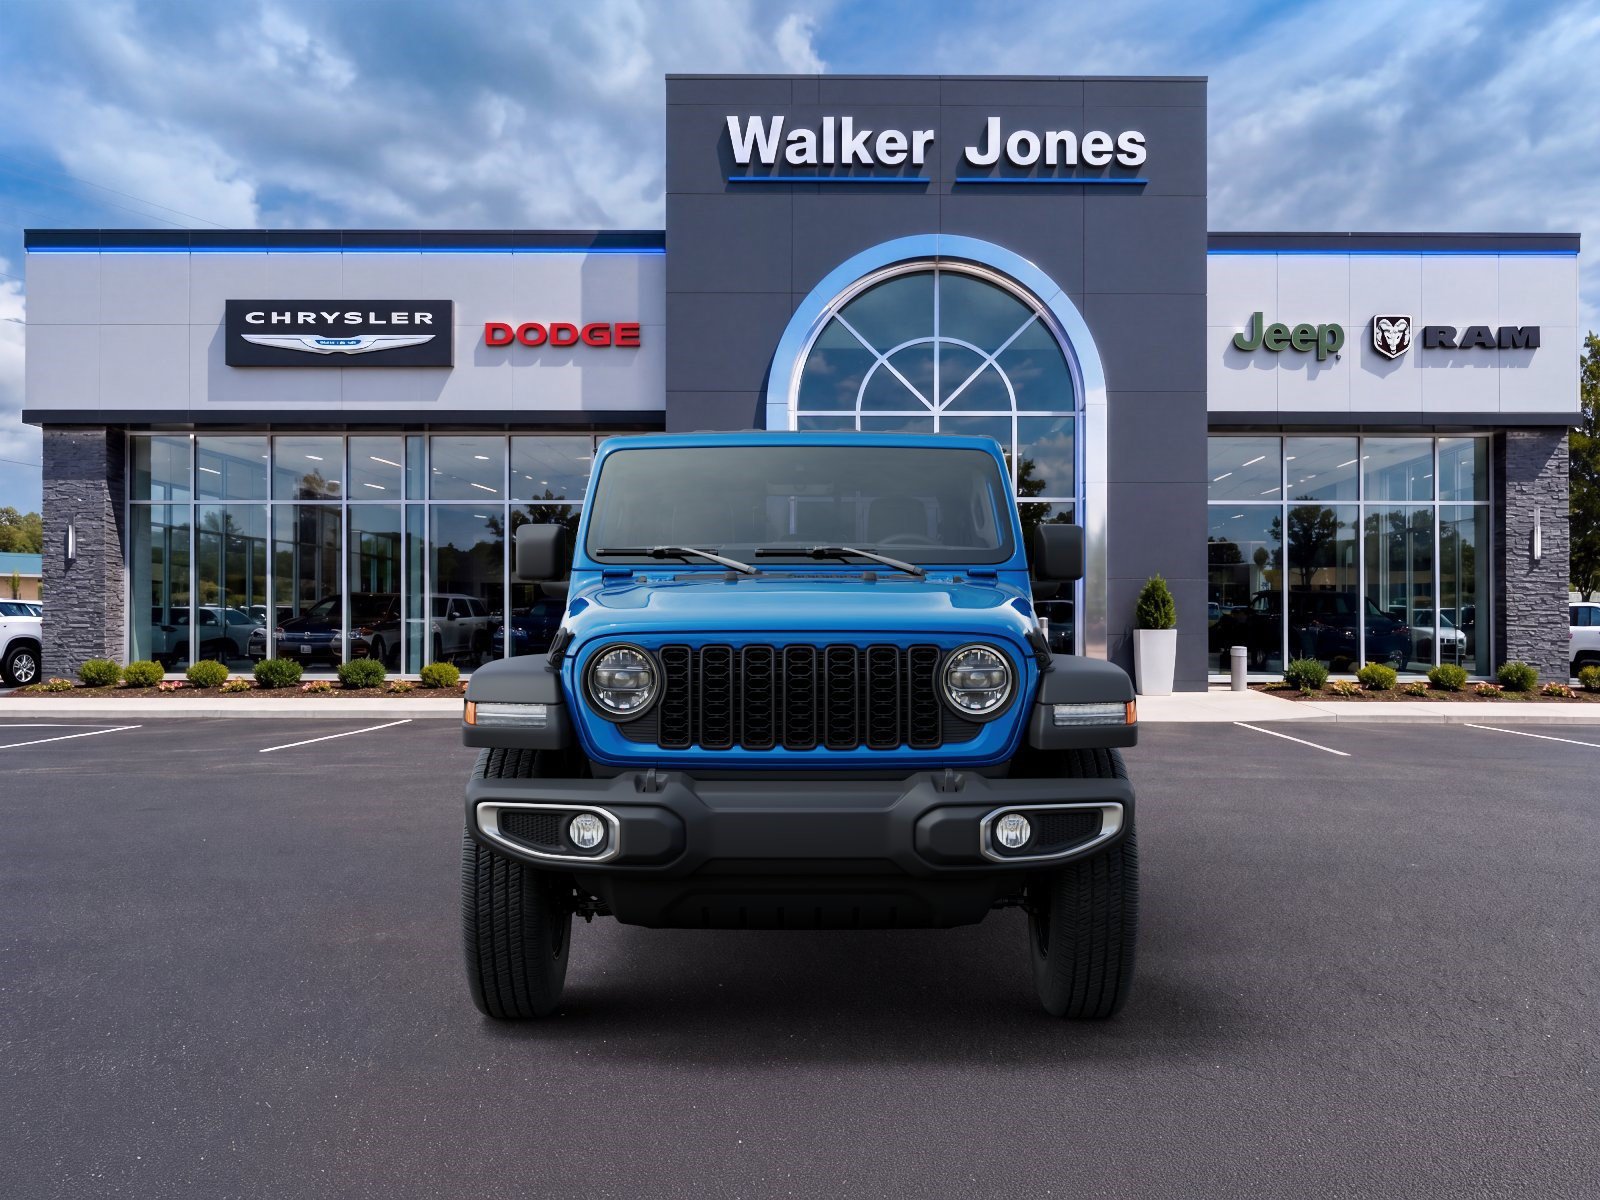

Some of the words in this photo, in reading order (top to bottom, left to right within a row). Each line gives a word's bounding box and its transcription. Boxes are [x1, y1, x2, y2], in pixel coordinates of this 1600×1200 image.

[726, 115, 935, 165] Walker
[964, 116, 1147, 166] Jones
[245, 311, 433, 325] CHRYSLER
[485, 322, 641, 347] DODGE
[1233, 311, 1345, 361] Jeep
[1423, 325, 1541, 349] RAM
